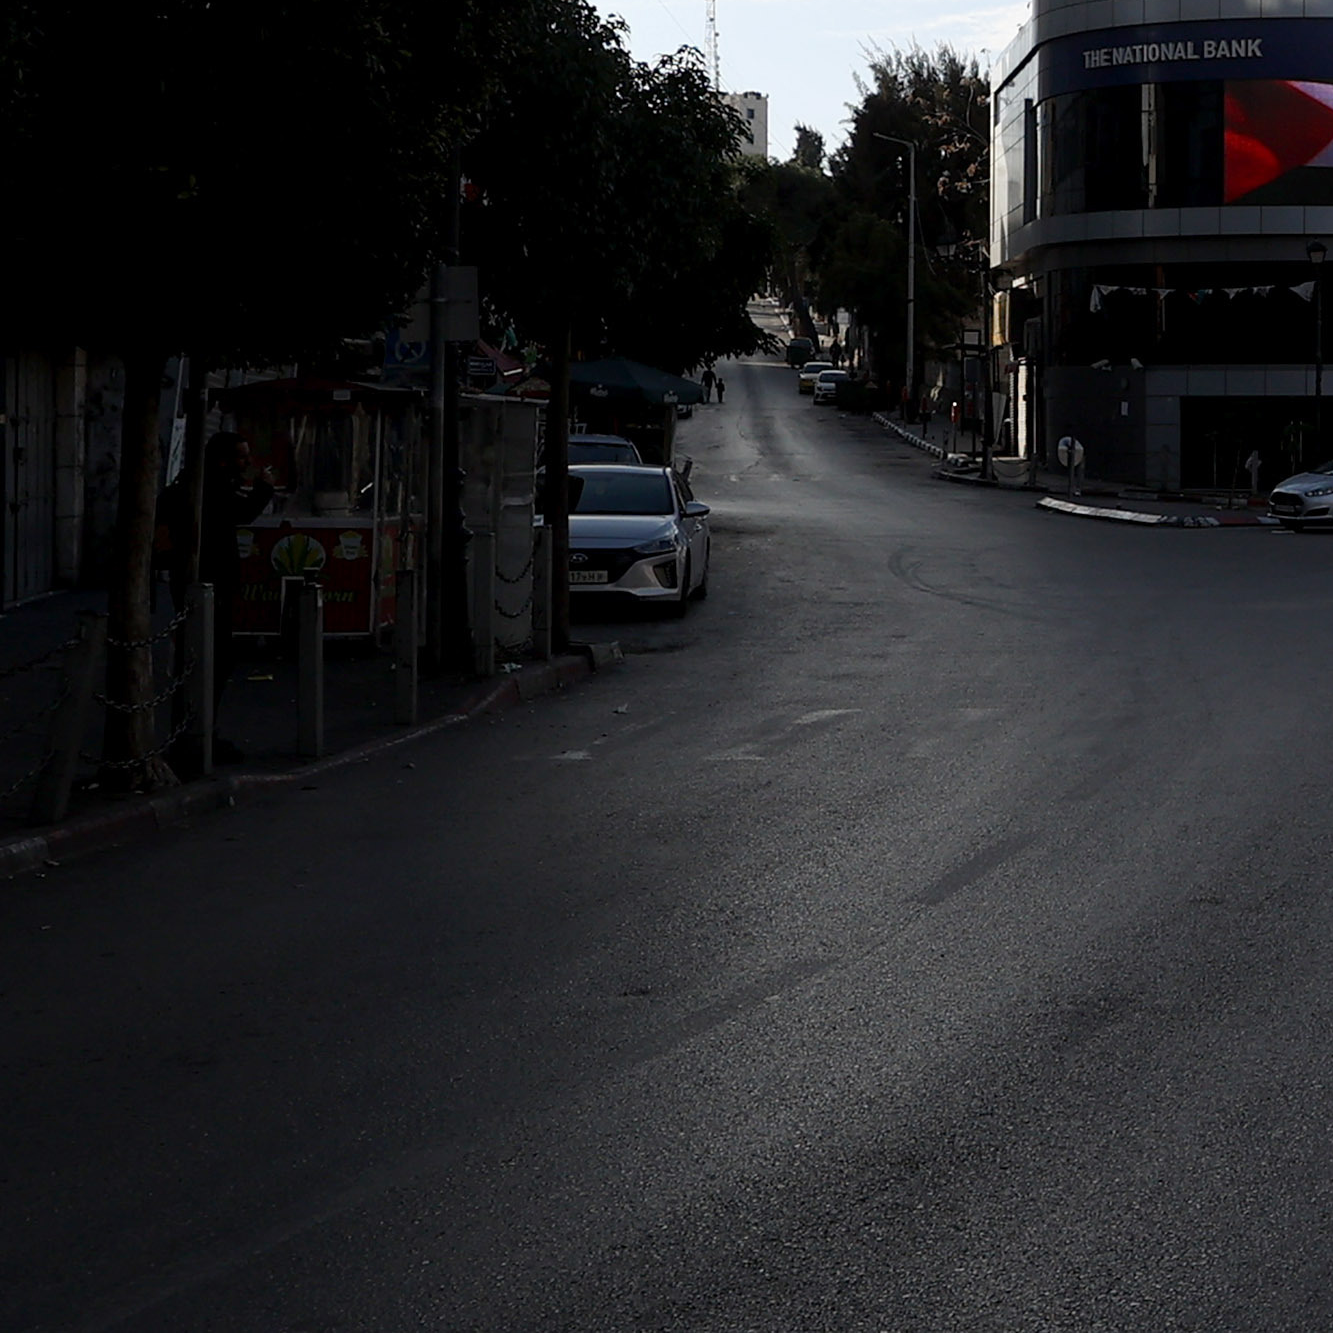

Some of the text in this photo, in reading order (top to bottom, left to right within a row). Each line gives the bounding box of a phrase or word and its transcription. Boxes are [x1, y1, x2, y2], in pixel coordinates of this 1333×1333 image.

[1082, 37, 1264, 70] THE NATIONAL BANK
